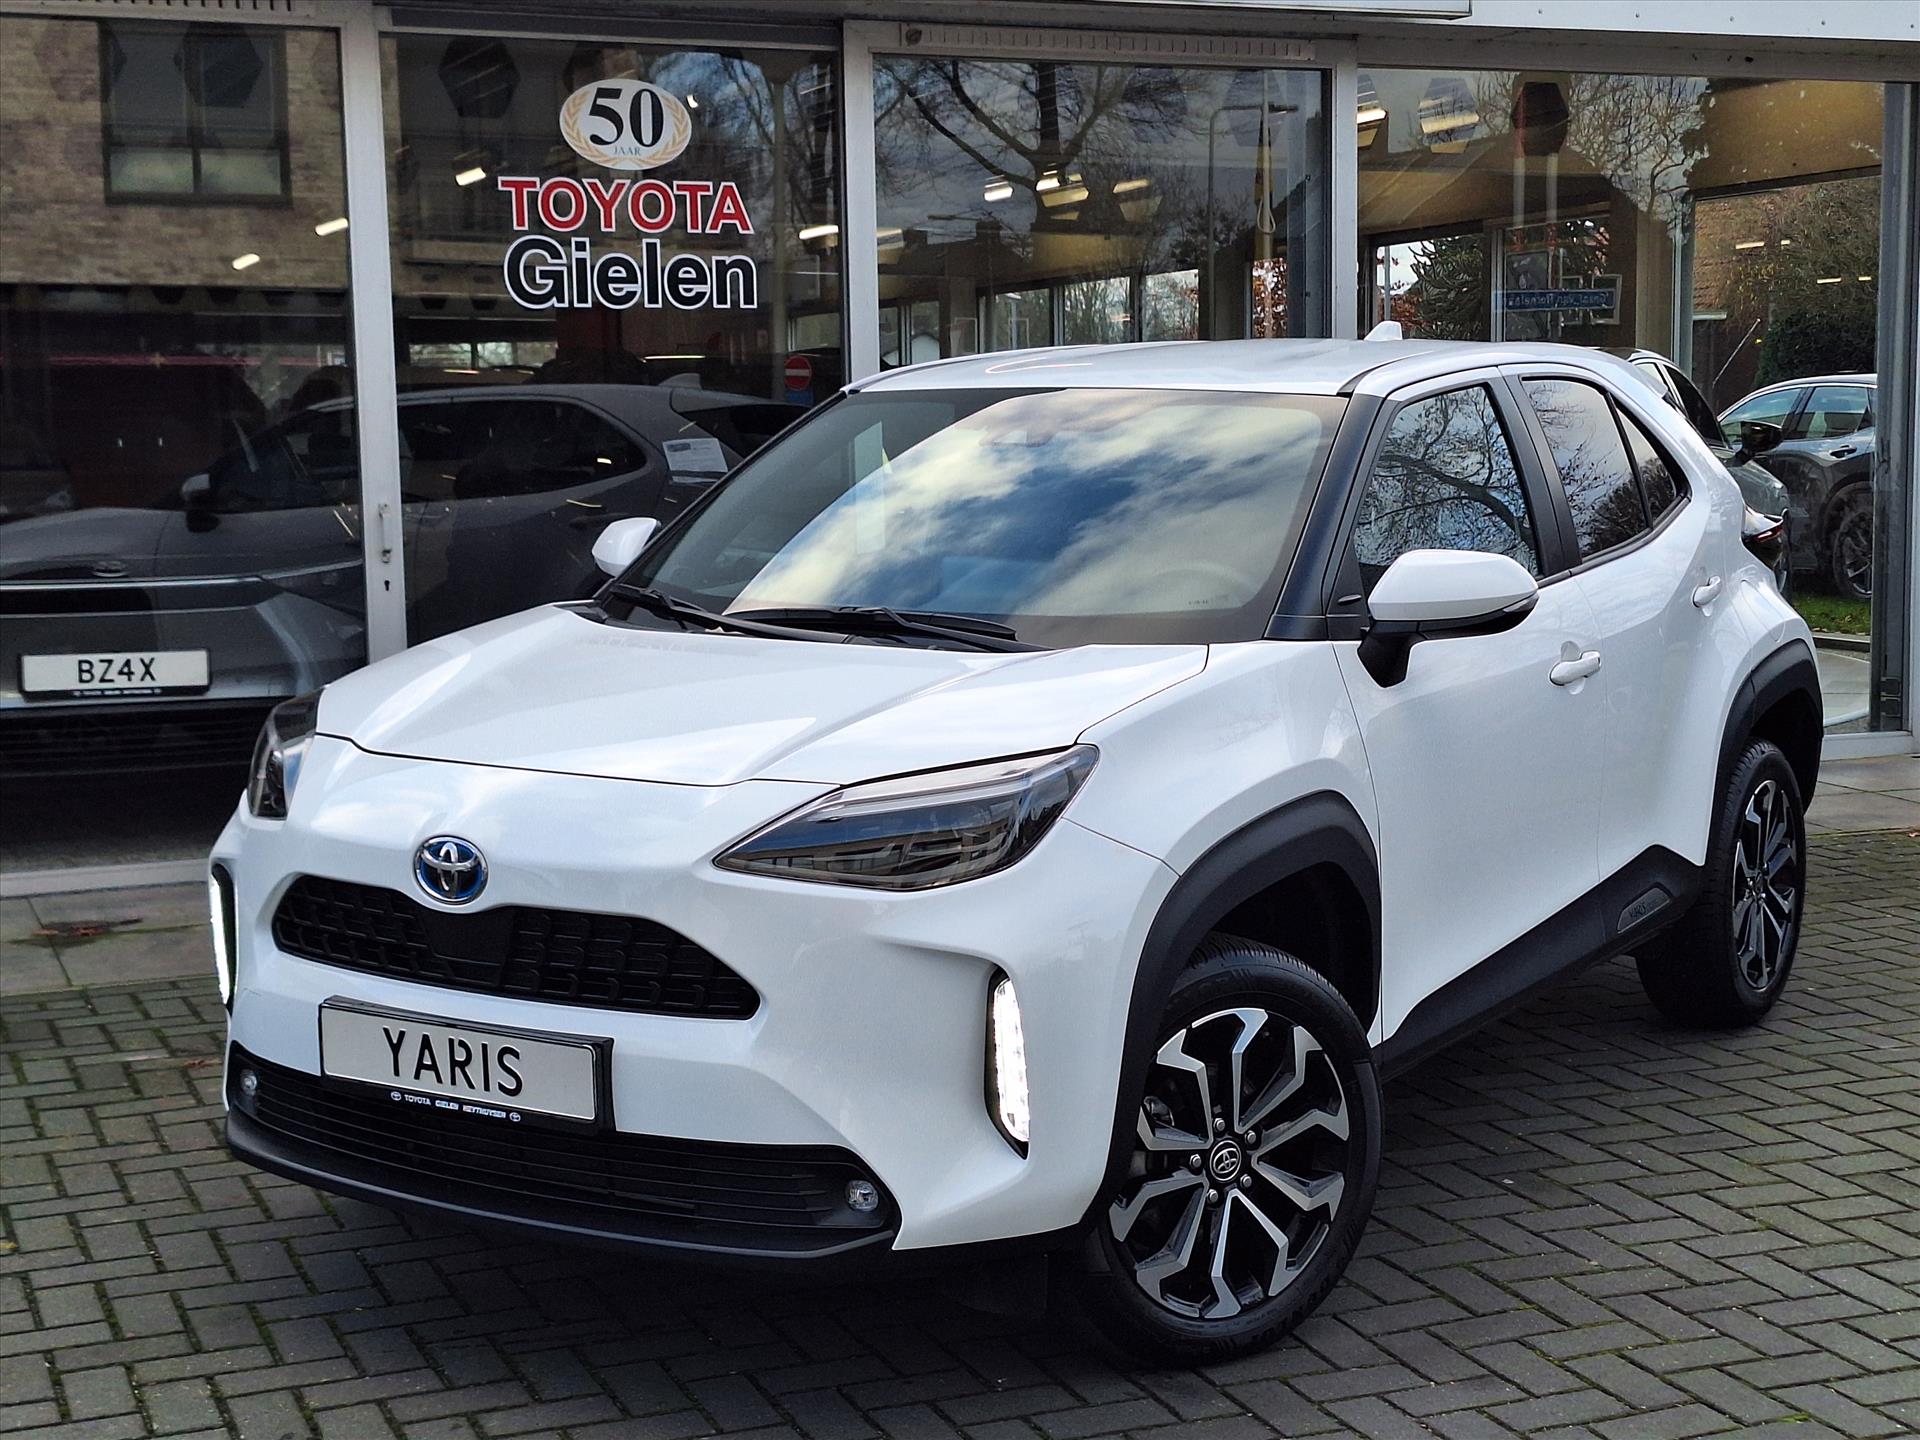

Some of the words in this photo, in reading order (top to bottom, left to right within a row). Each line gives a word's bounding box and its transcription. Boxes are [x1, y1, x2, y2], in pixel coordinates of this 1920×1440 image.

[589, 87, 664, 147] 50
[613, 146, 641, 157] JAAR
[498, 176, 754, 234] TOYOTA
[504, 235, 757, 309] Gielen
[78, 657, 156, 683] BZ4X
[383, 1026, 523, 1097] YARIS
[404, 1094, 431, 1105] TOYOTA
